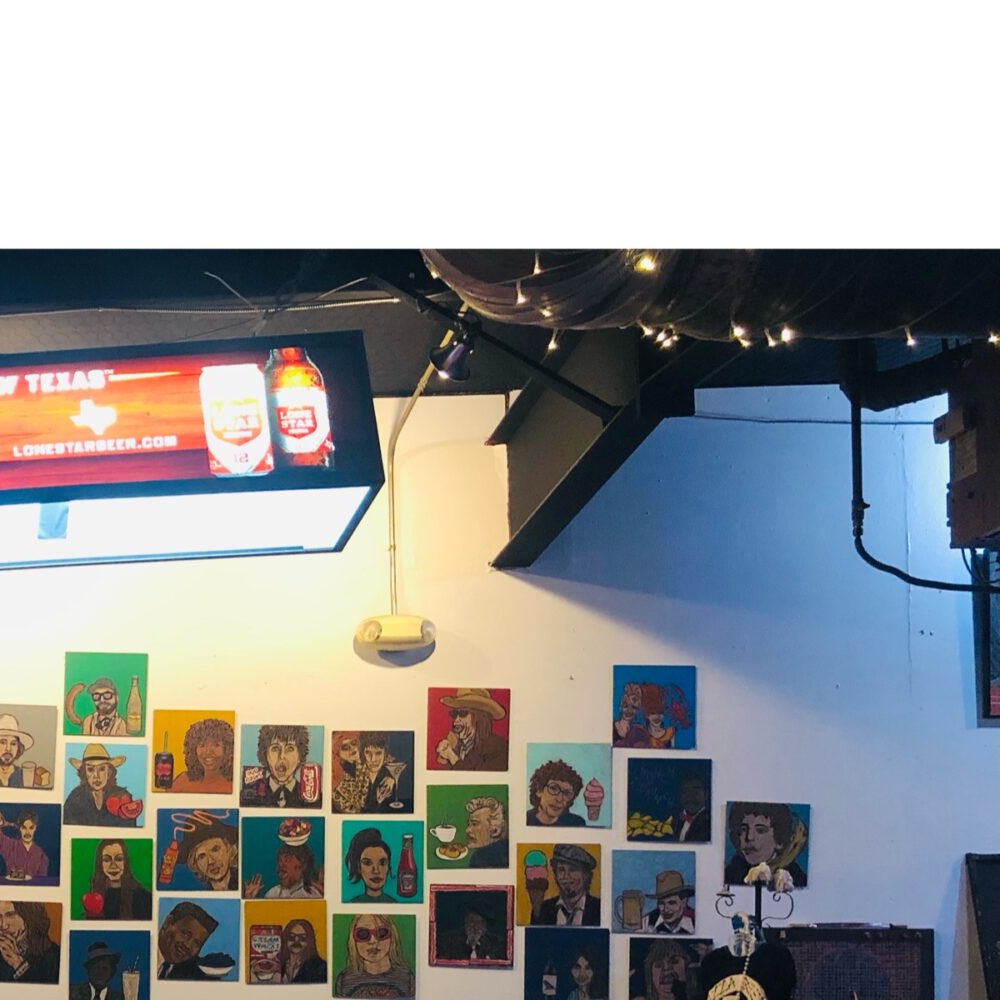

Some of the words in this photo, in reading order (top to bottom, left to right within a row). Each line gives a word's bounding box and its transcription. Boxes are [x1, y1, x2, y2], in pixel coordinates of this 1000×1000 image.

[280, 410, 312, 420] LONE
[281, 419, 313, 429] STAR
[13, 435, 178, 458] LONESTARBEER.COM
